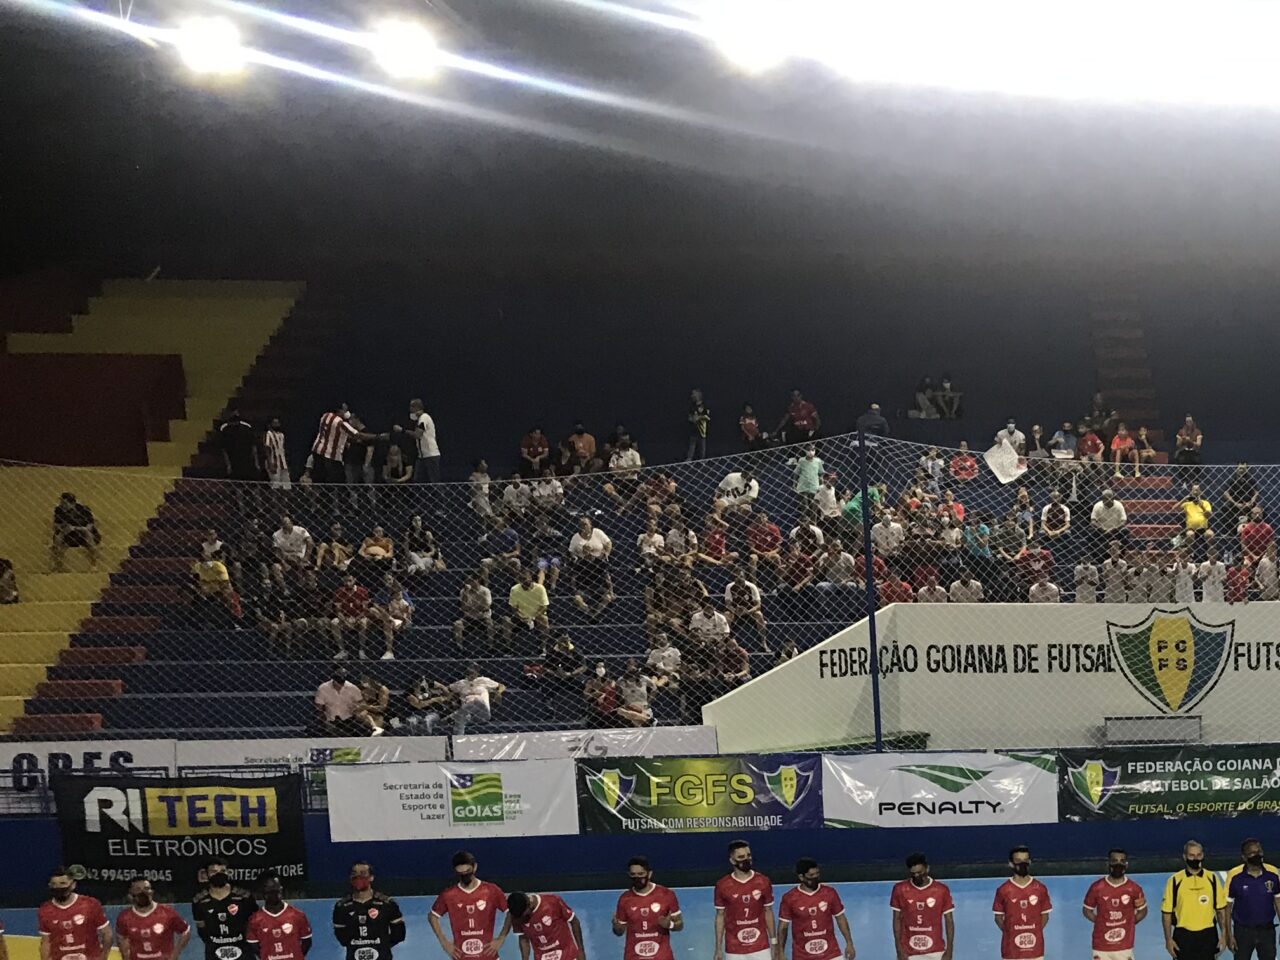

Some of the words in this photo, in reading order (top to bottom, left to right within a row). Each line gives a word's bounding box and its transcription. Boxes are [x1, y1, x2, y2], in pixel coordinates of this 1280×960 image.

[926, 644, 1008, 674] GOIANA
[1013, 643, 1039, 674] DE
[1047, 642, 1116, 674] FUTSAL
[1127, 758, 1213, 775] FEDERAÇÃO
[1216, 758, 1273, 772] GOIANA
[383, 782, 430, 790] Secretaria
[432, 781, 443, 789] de
[1212, 778, 1231, 790] DE
[399, 792, 430, 800] Estado
[433, 791, 444, 799] de
[649, 773, 756, 807] FGFS
[156, 794, 267, 828] TECH
[402, 802, 437, 812] Esporte
[878, 800, 1002, 816] PENALTY
[1128, 803, 1174, 815] FUTSAL,
[1176, 803, 1185, 813] O
[1187, 801, 1235, 813] ESPORTE
[420, 811, 446, 820] Lazer
[662, 818, 684, 829] COM
[687, 815, 783, 829] RESPONSABILIDADE
[107, 835, 268, 857] ELETRÔNICOS
[743, 908, 749, 918] 7
[469, 919, 475, 928] 11
[811, 920, 818, 929] 6
[916, 915, 923, 924] 5
[219, 924, 229, 934] 14
[359, 926, 368, 937] 12
